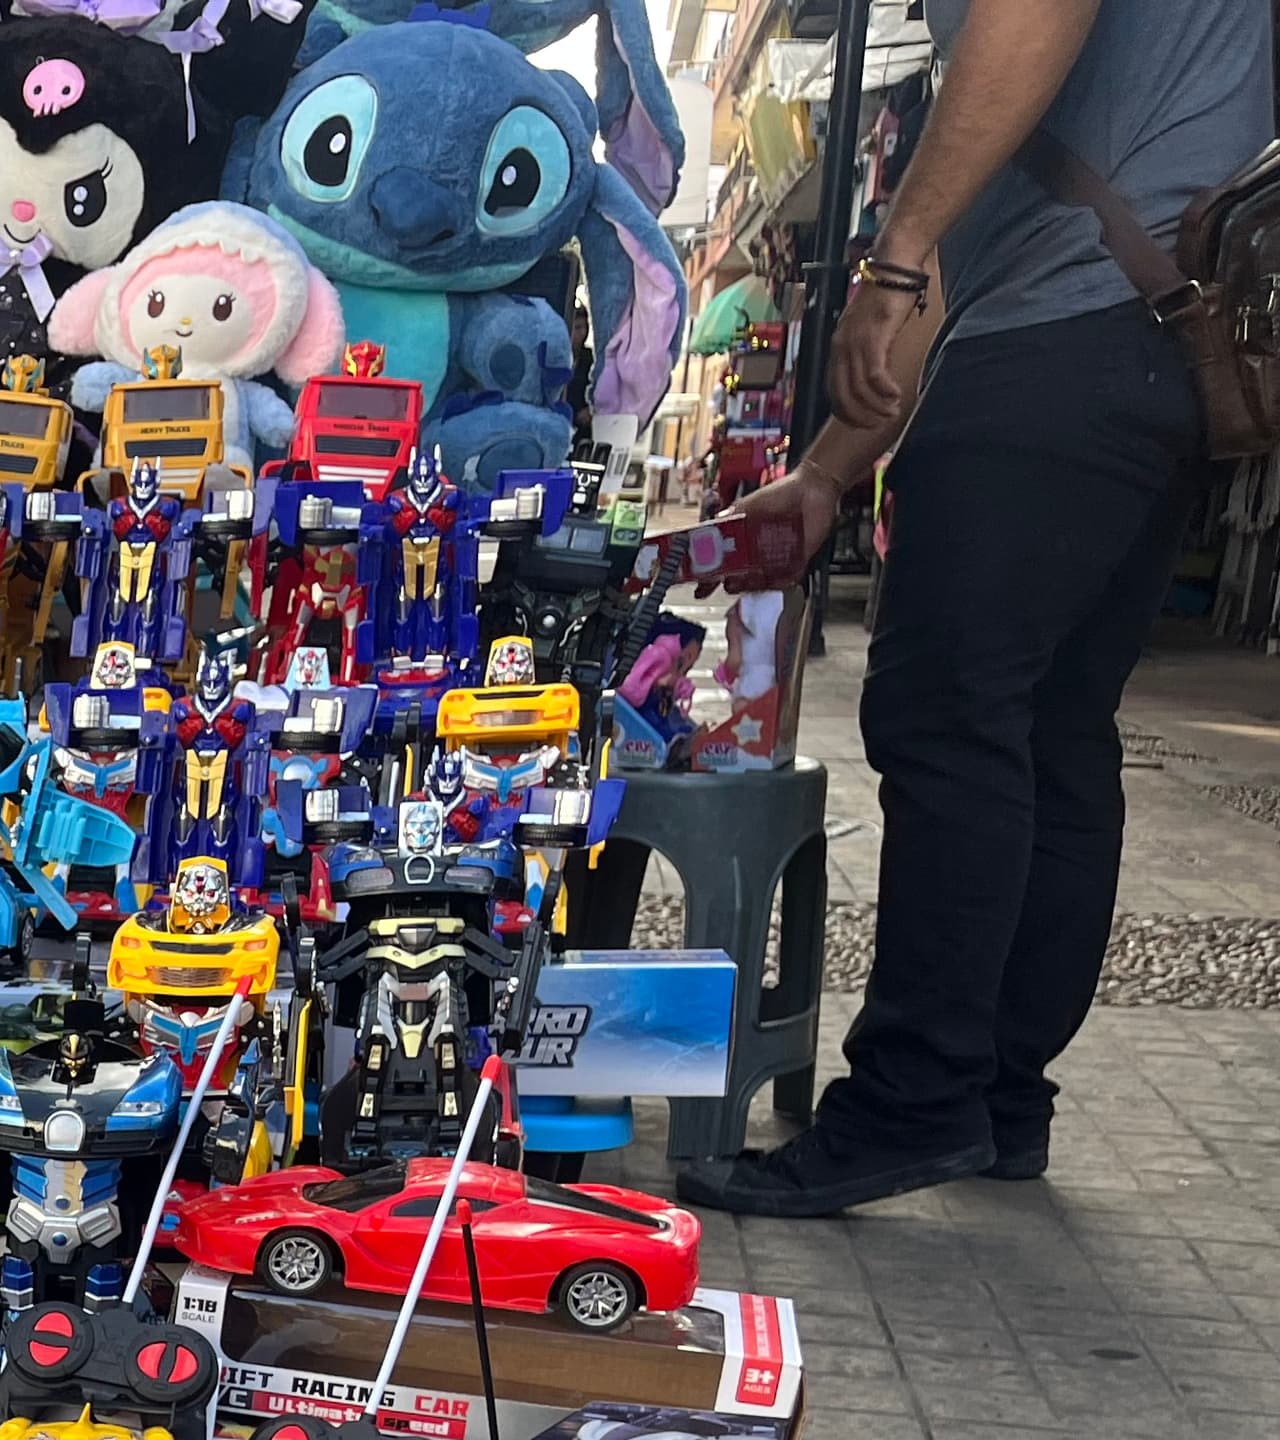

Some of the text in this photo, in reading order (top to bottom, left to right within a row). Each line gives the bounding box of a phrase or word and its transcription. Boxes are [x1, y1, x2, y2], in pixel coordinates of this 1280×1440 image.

[183, 1295, 218, 1315] 1:18
[181, 1311, 216, 1324] SCALE
[744, 1367, 775, 1384] 3+
[220, 1366, 274, 1389] IFT
[414, 1394, 470, 1418] CAR
[743, 1382, 772, 1396] AGES
